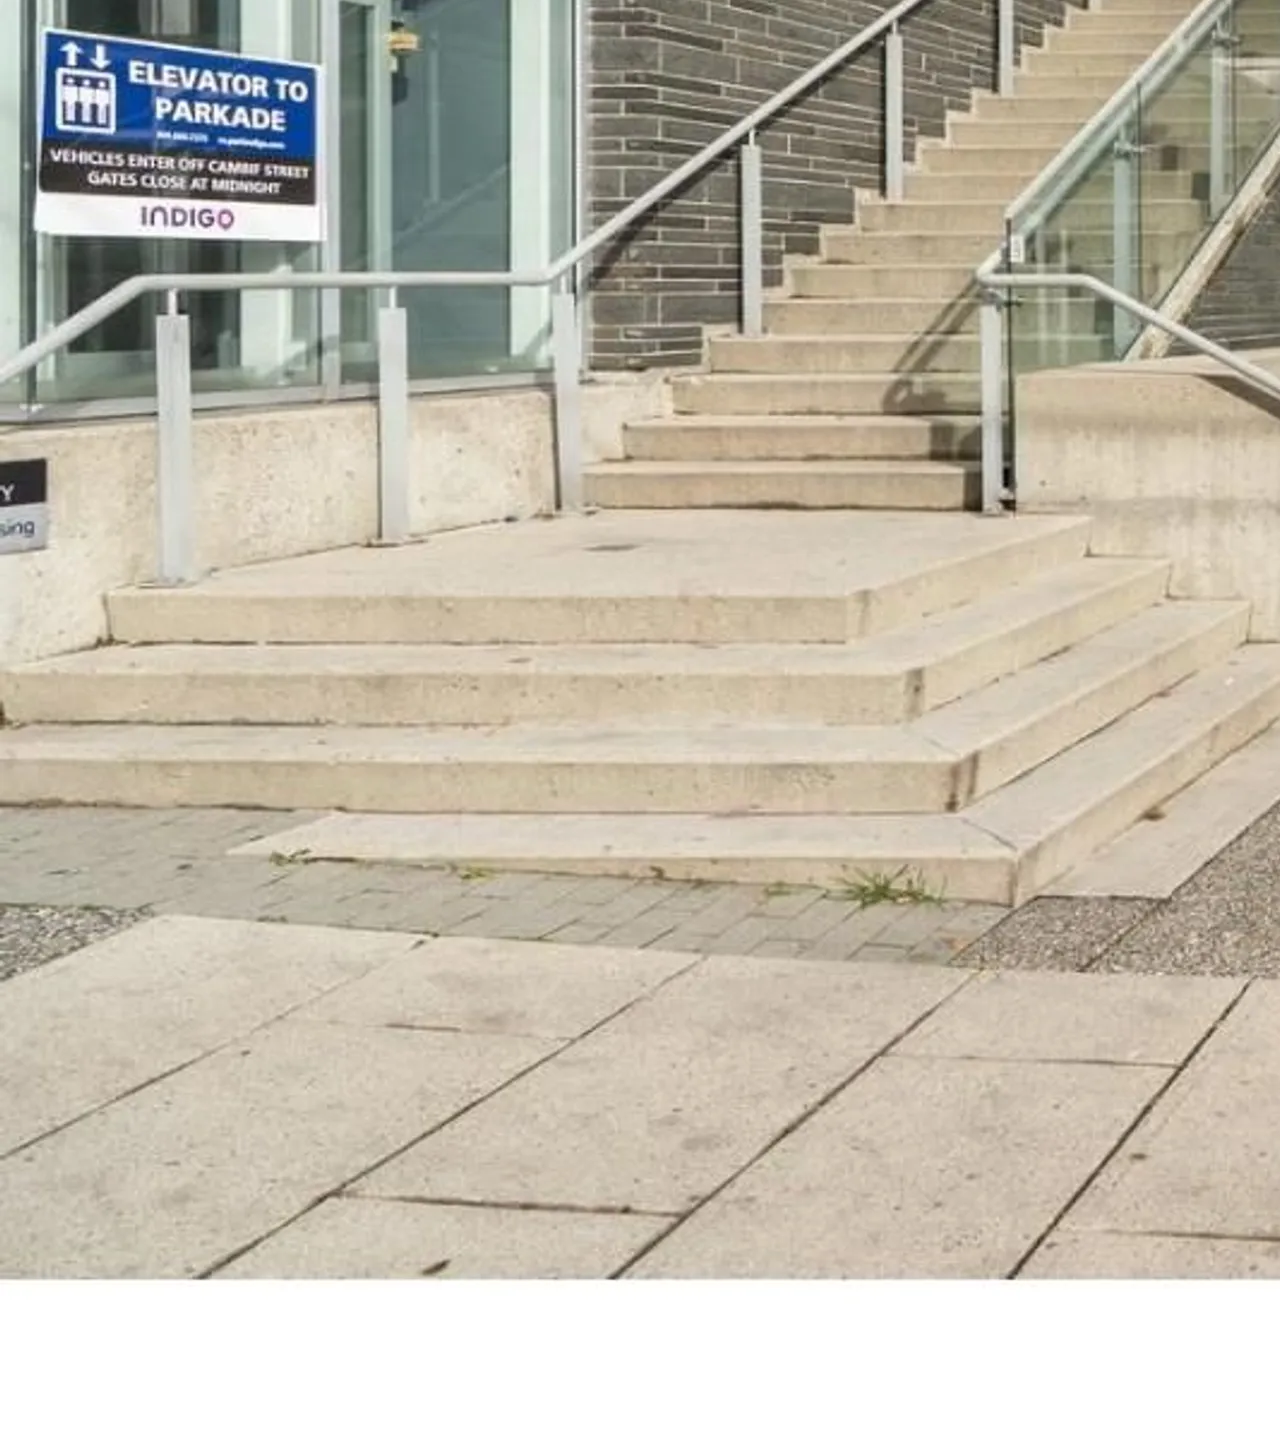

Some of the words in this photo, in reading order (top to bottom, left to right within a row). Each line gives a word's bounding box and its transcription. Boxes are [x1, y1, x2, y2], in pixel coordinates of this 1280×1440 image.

[128, 59, 269, 99] ELEVATOR
[275, 78, 309, 103] TO
[155, 97, 287, 133] PARKADE
[50, 148, 125, 167] VEHICLES
[127, 153, 176, 169] ENTER
[178, 157, 205, 172] OFF
[264, 164, 311, 179] STREET
[87, 170, 138, 187] GATES
[141, 173, 188, 189] CLOSE
[190, 177, 209, 191] AT
[211, 178, 283, 194] MIDNIGHT
